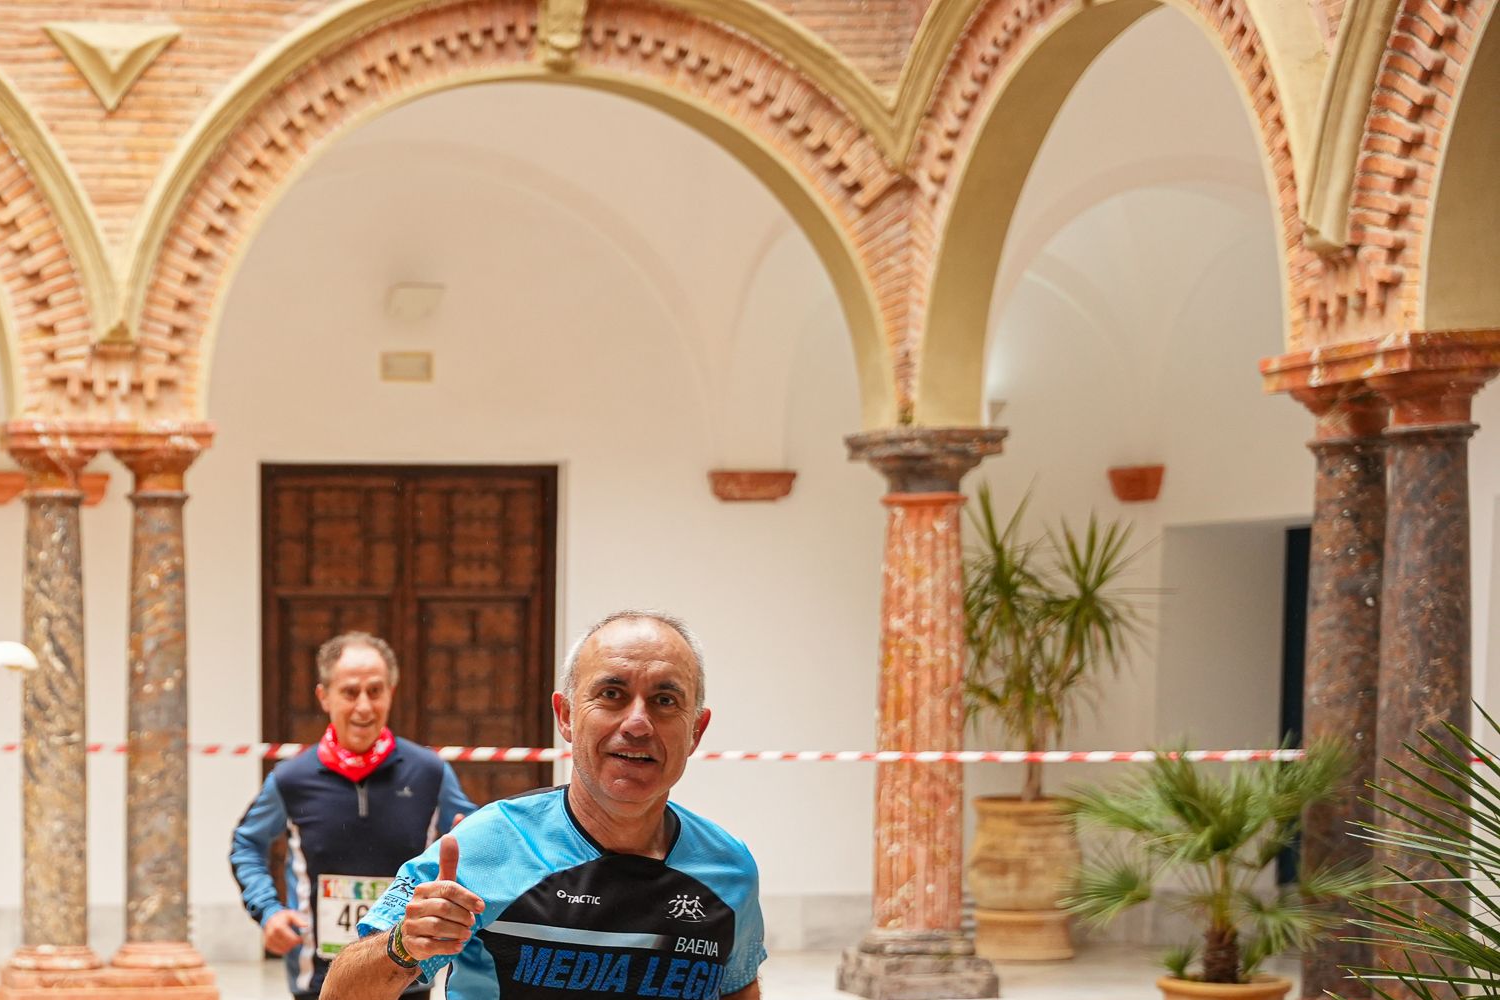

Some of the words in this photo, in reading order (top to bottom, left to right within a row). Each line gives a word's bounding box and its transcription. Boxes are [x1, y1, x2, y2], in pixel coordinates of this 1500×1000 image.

[567, 894, 601, 905] TACTIC
[674, 936, 719, 957] BAENA
[512, 944, 631, 993] MEDIA
